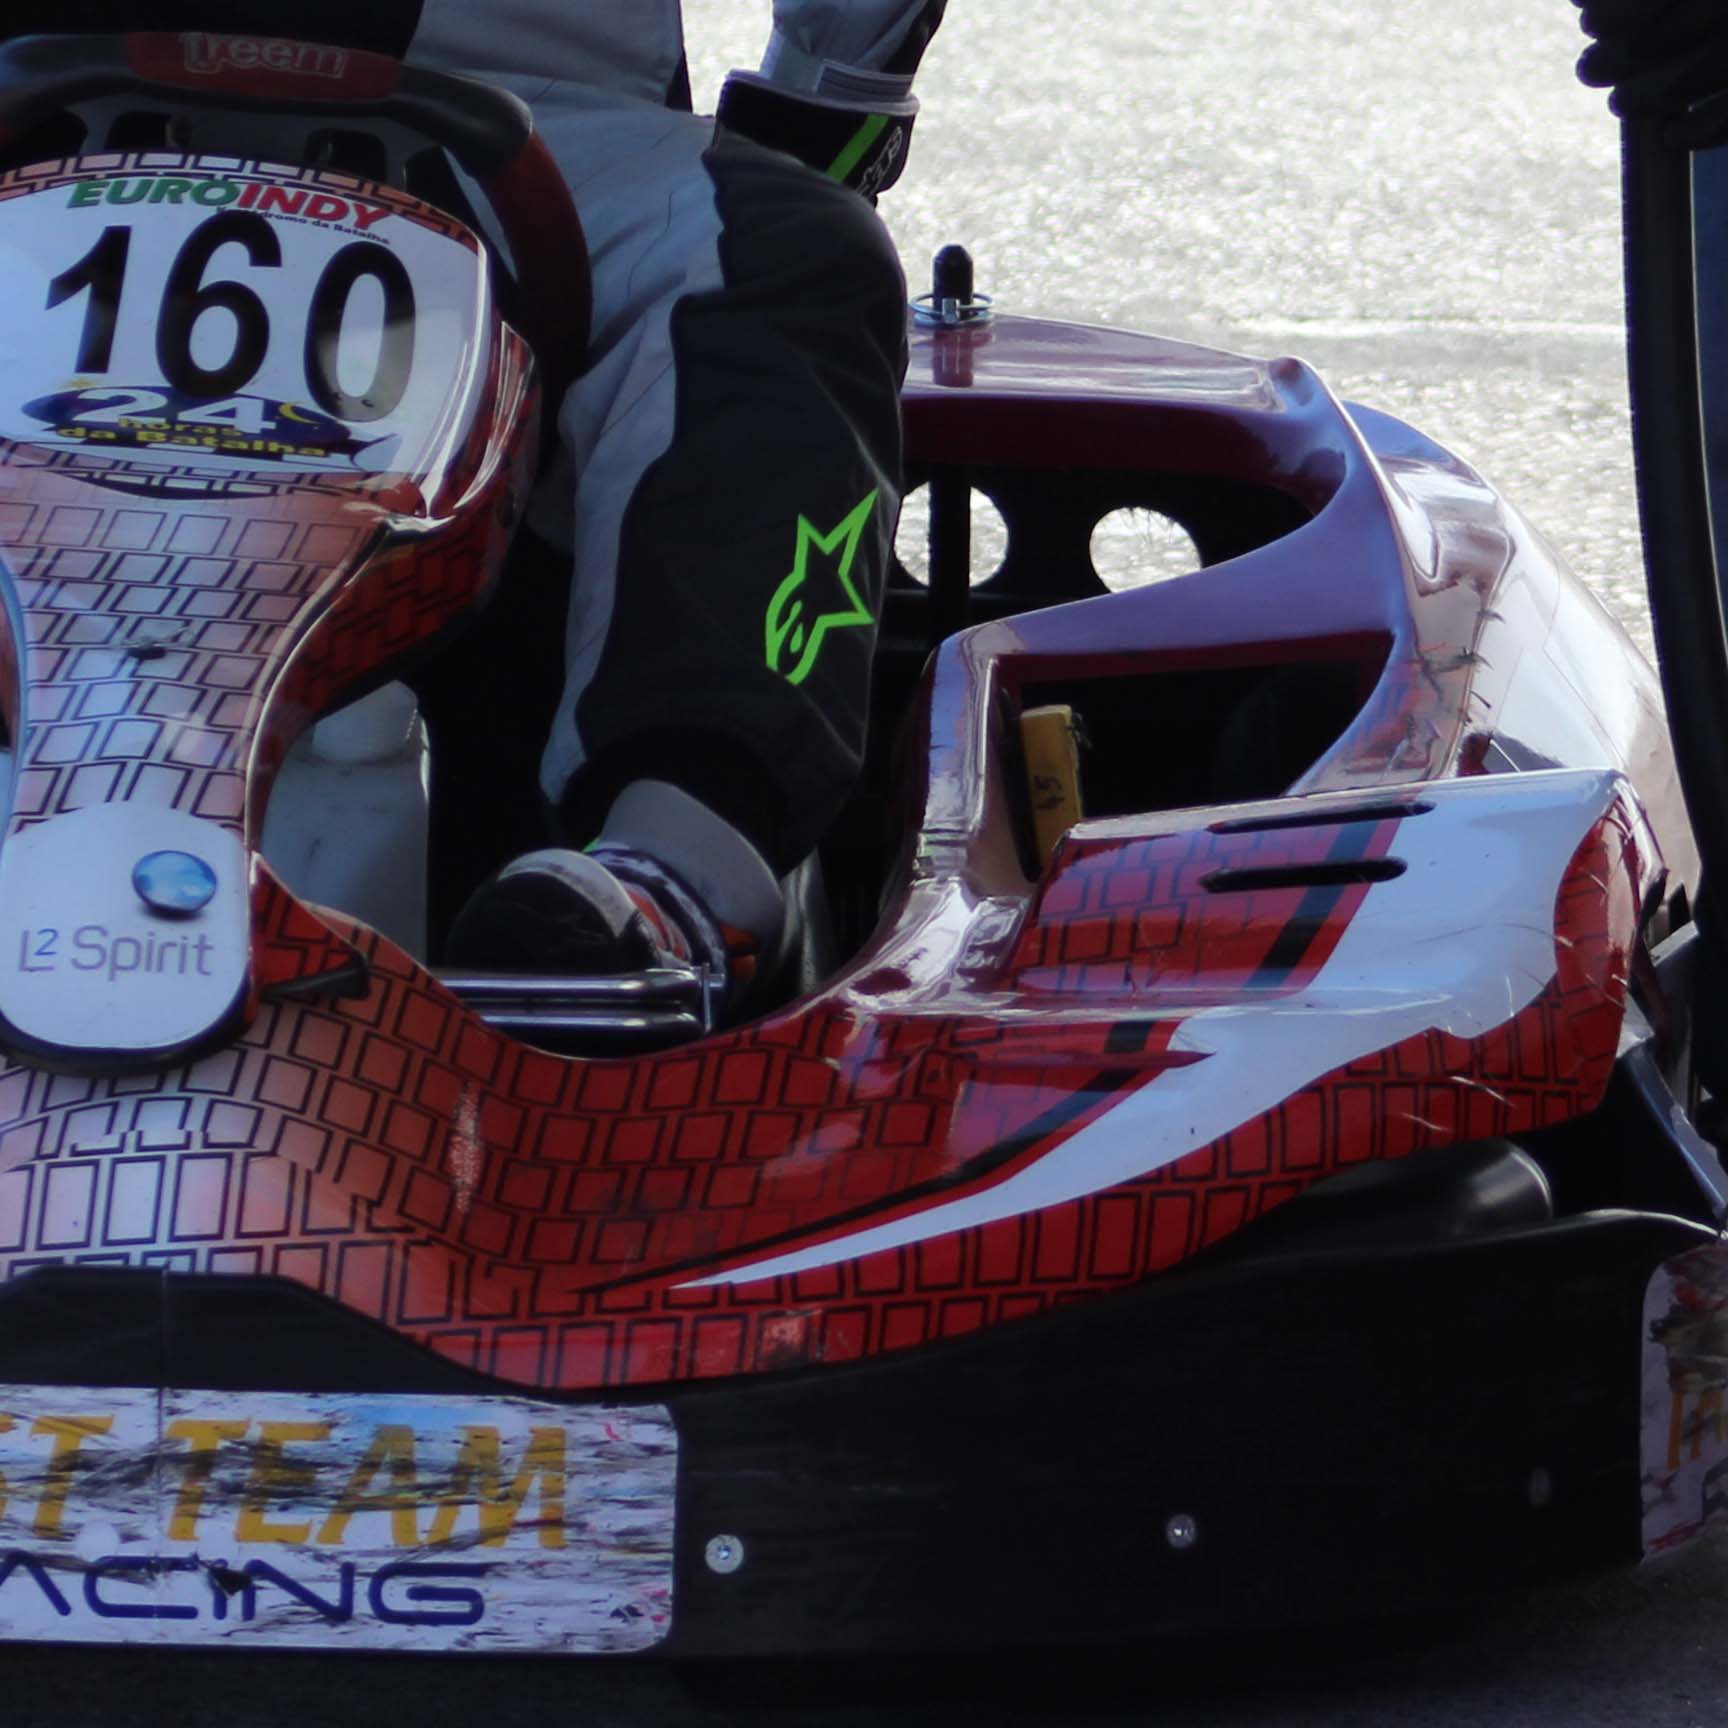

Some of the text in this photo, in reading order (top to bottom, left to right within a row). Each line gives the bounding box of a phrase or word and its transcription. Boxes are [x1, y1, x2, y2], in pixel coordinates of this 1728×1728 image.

[66, 178, 393, 230] EUROINDY
[45, 209, 416, 422] 160
[72, 387, 276, 434] 24
[118, 417, 243, 436] horas
[56, 426, 328, 457] da Batalha
[71, 924, 215, 982] Spirit
[168, 1419, 568, 1550] TEAM
